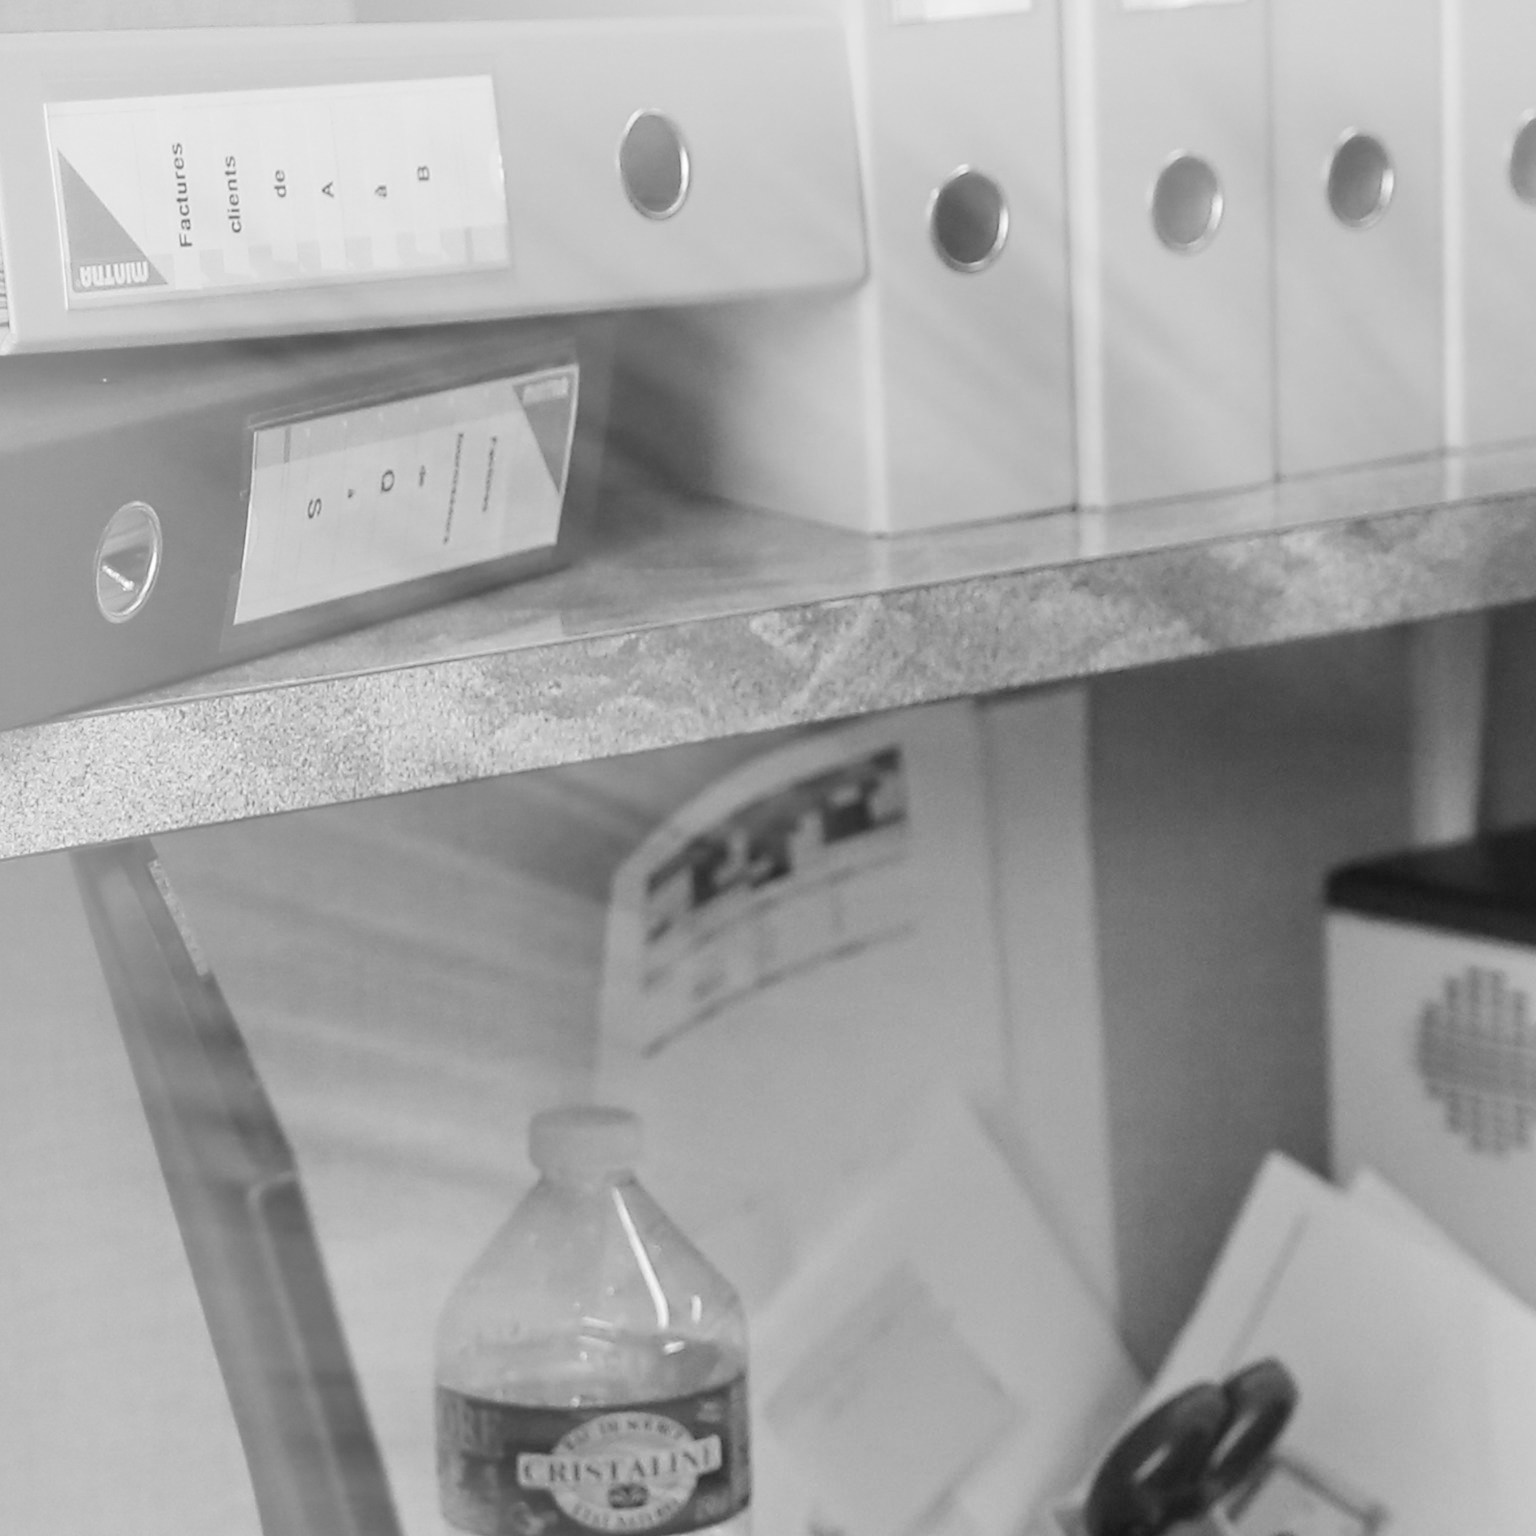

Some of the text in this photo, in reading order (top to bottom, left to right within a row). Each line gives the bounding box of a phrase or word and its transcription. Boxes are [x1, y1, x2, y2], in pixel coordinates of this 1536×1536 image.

[274, 169, 288, 198] de
[416, 165, 430, 181] B
[172, 142, 192, 248] Factures
[225, 155, 242, 233] clients
[321, 181, 335, 198] A
[307, 498, 322, 519] S
